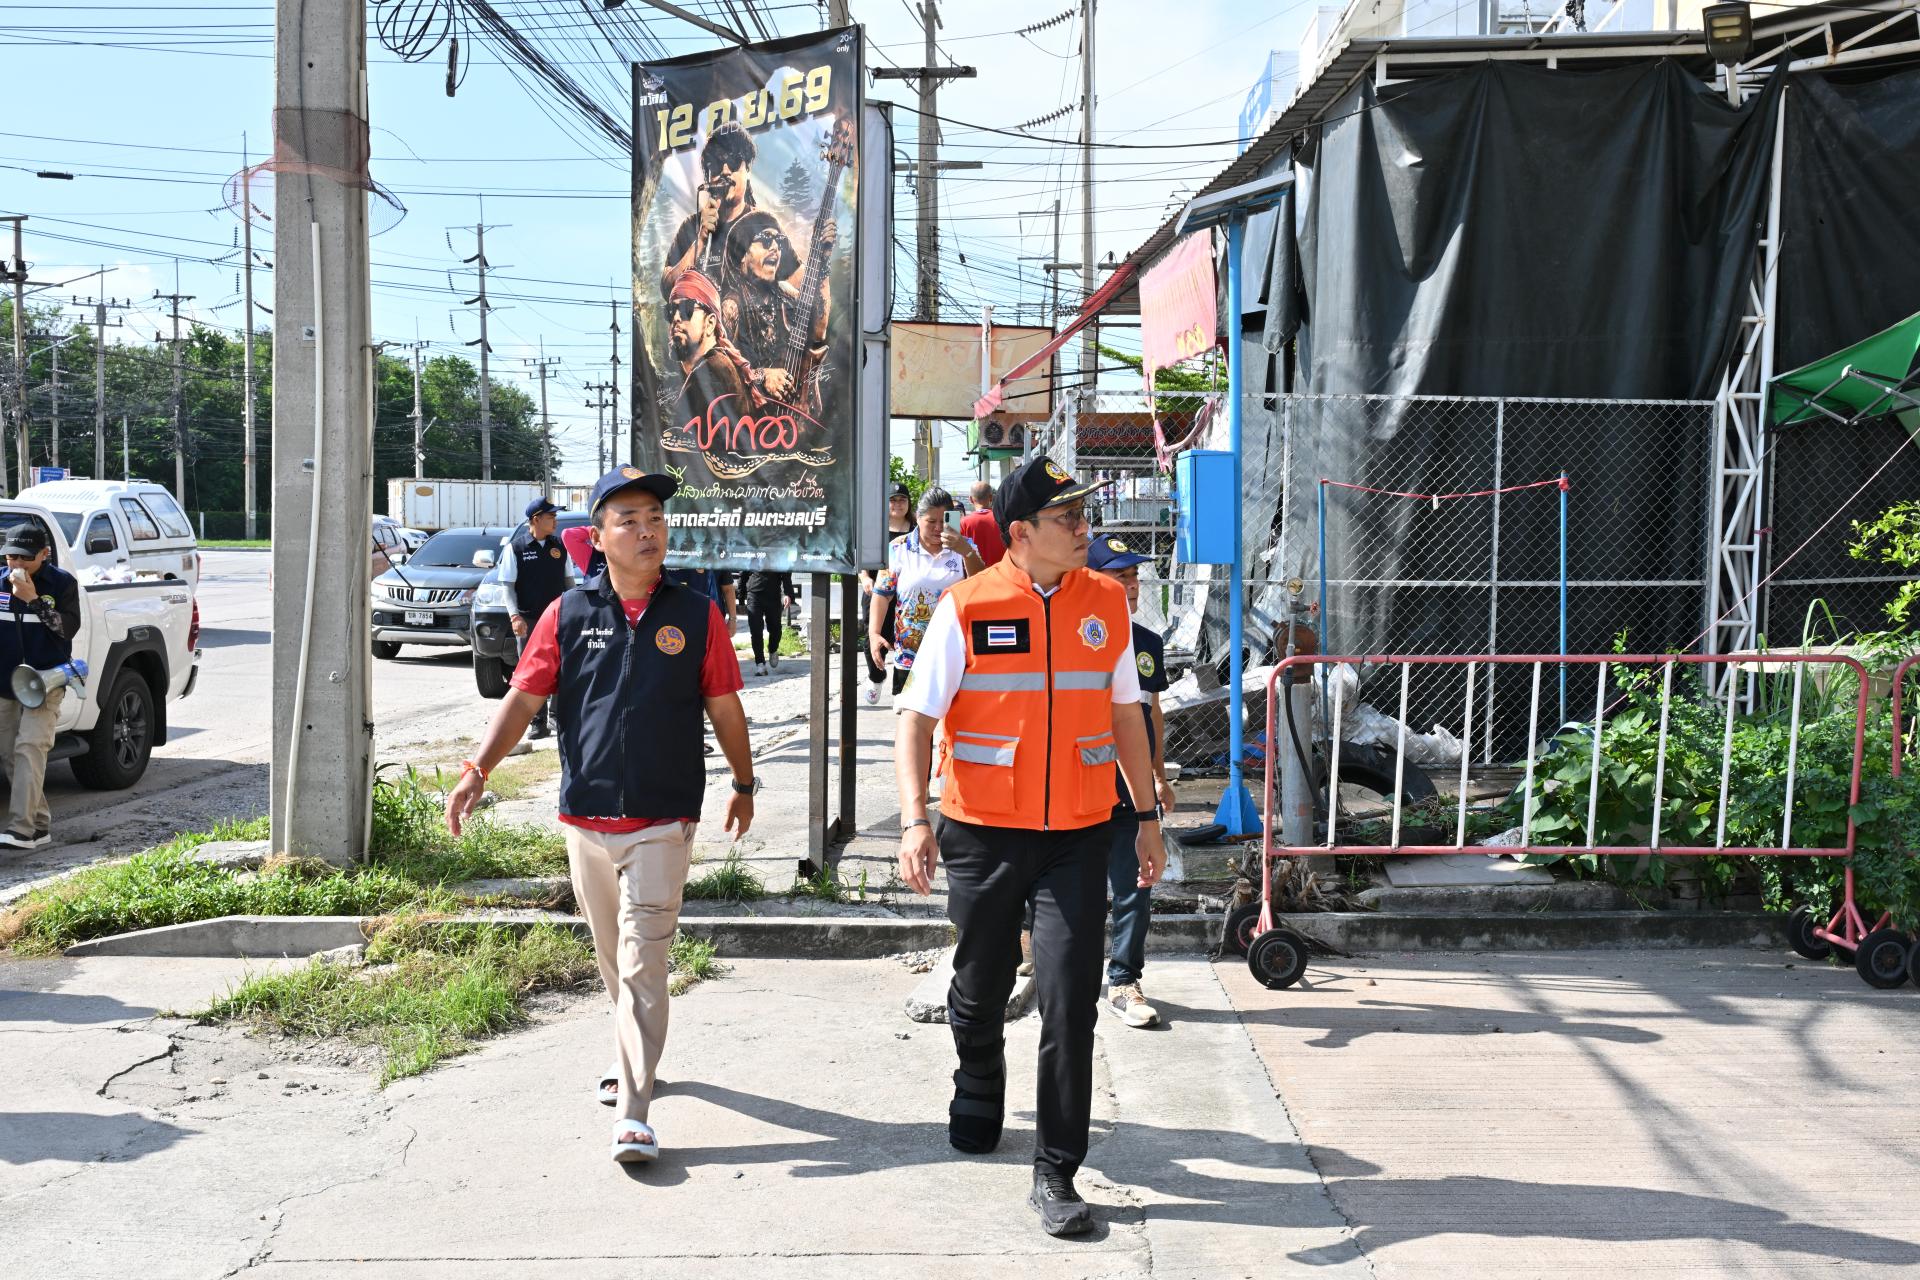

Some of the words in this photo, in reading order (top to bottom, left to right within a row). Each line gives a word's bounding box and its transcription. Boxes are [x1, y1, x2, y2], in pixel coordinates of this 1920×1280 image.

[836, 44, 850, 54] only
[657, 103, 694, 151] 12
[744, 505, 828, 533] อมตะชลบุรี
